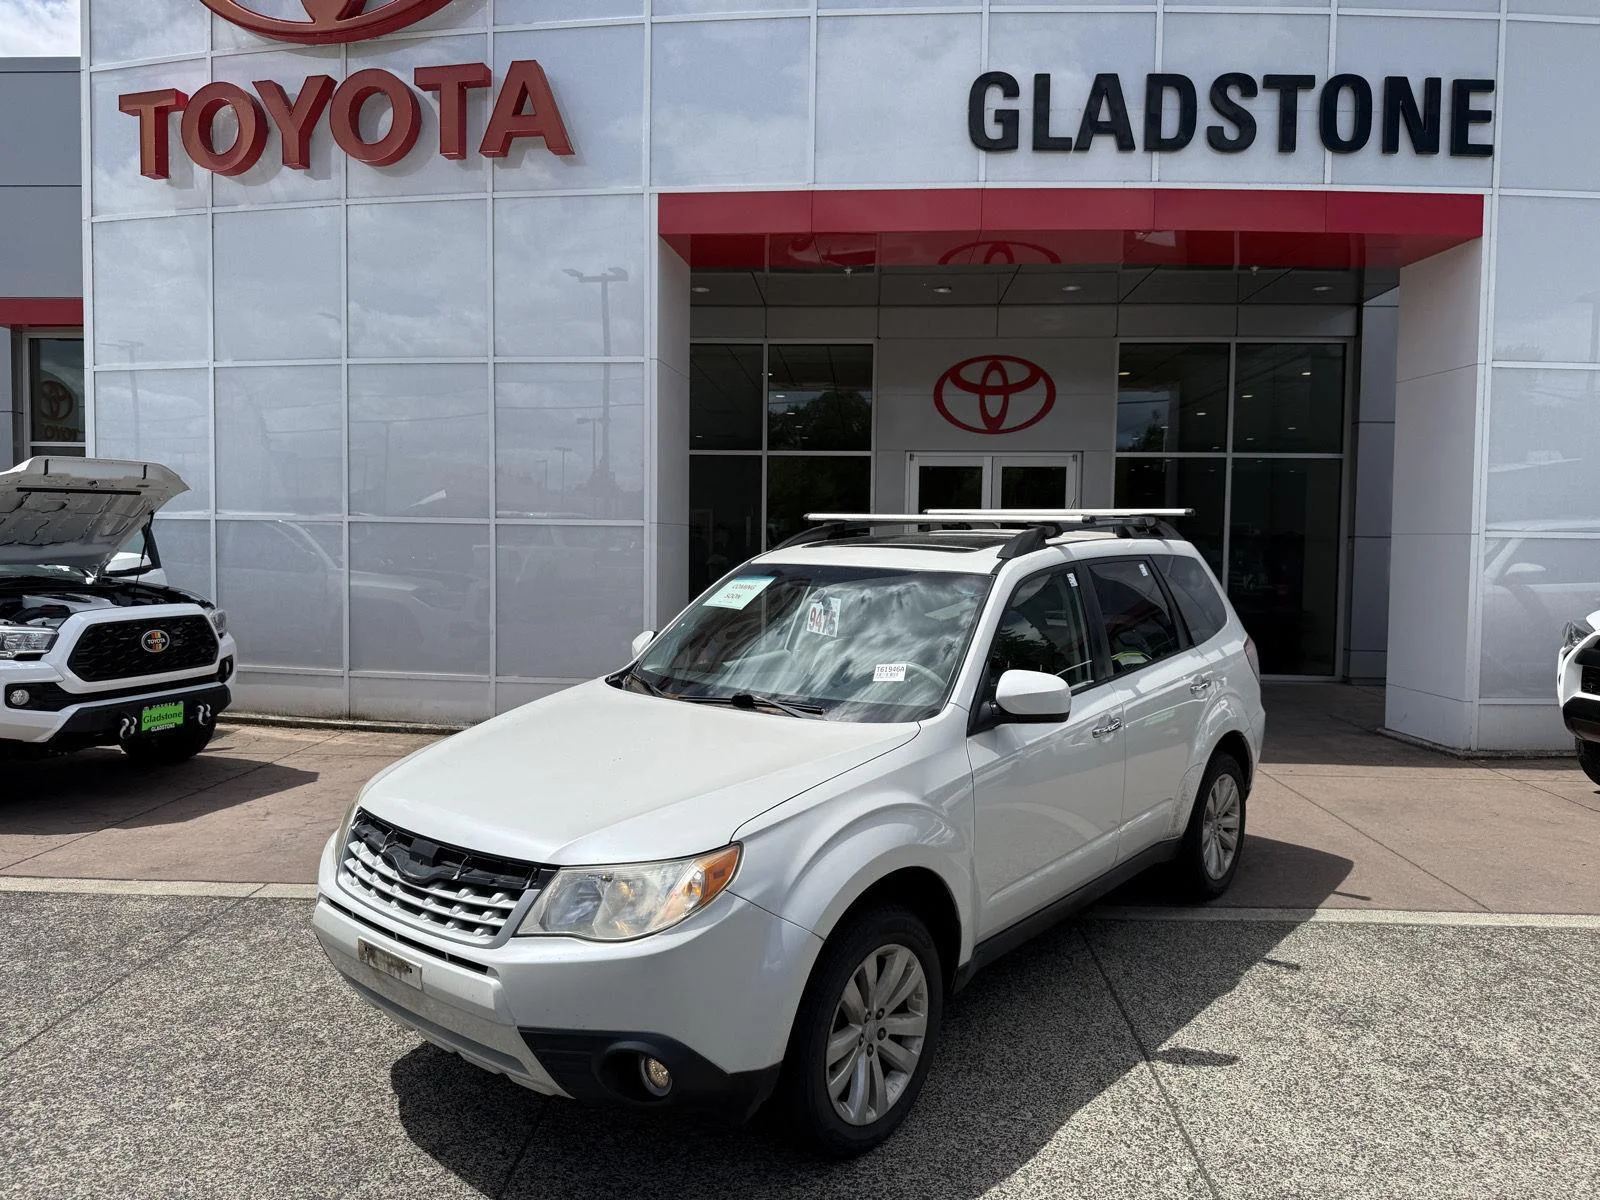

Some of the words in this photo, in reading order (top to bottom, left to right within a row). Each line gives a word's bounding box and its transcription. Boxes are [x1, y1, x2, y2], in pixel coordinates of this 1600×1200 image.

[118, 59, 575, 180] TOYOTA
[968, 71, 1495, 157] GLADSTONE
[143, 711, 183, 724] Gladstone
[151, 723, 175, 731] GLADSTONE
